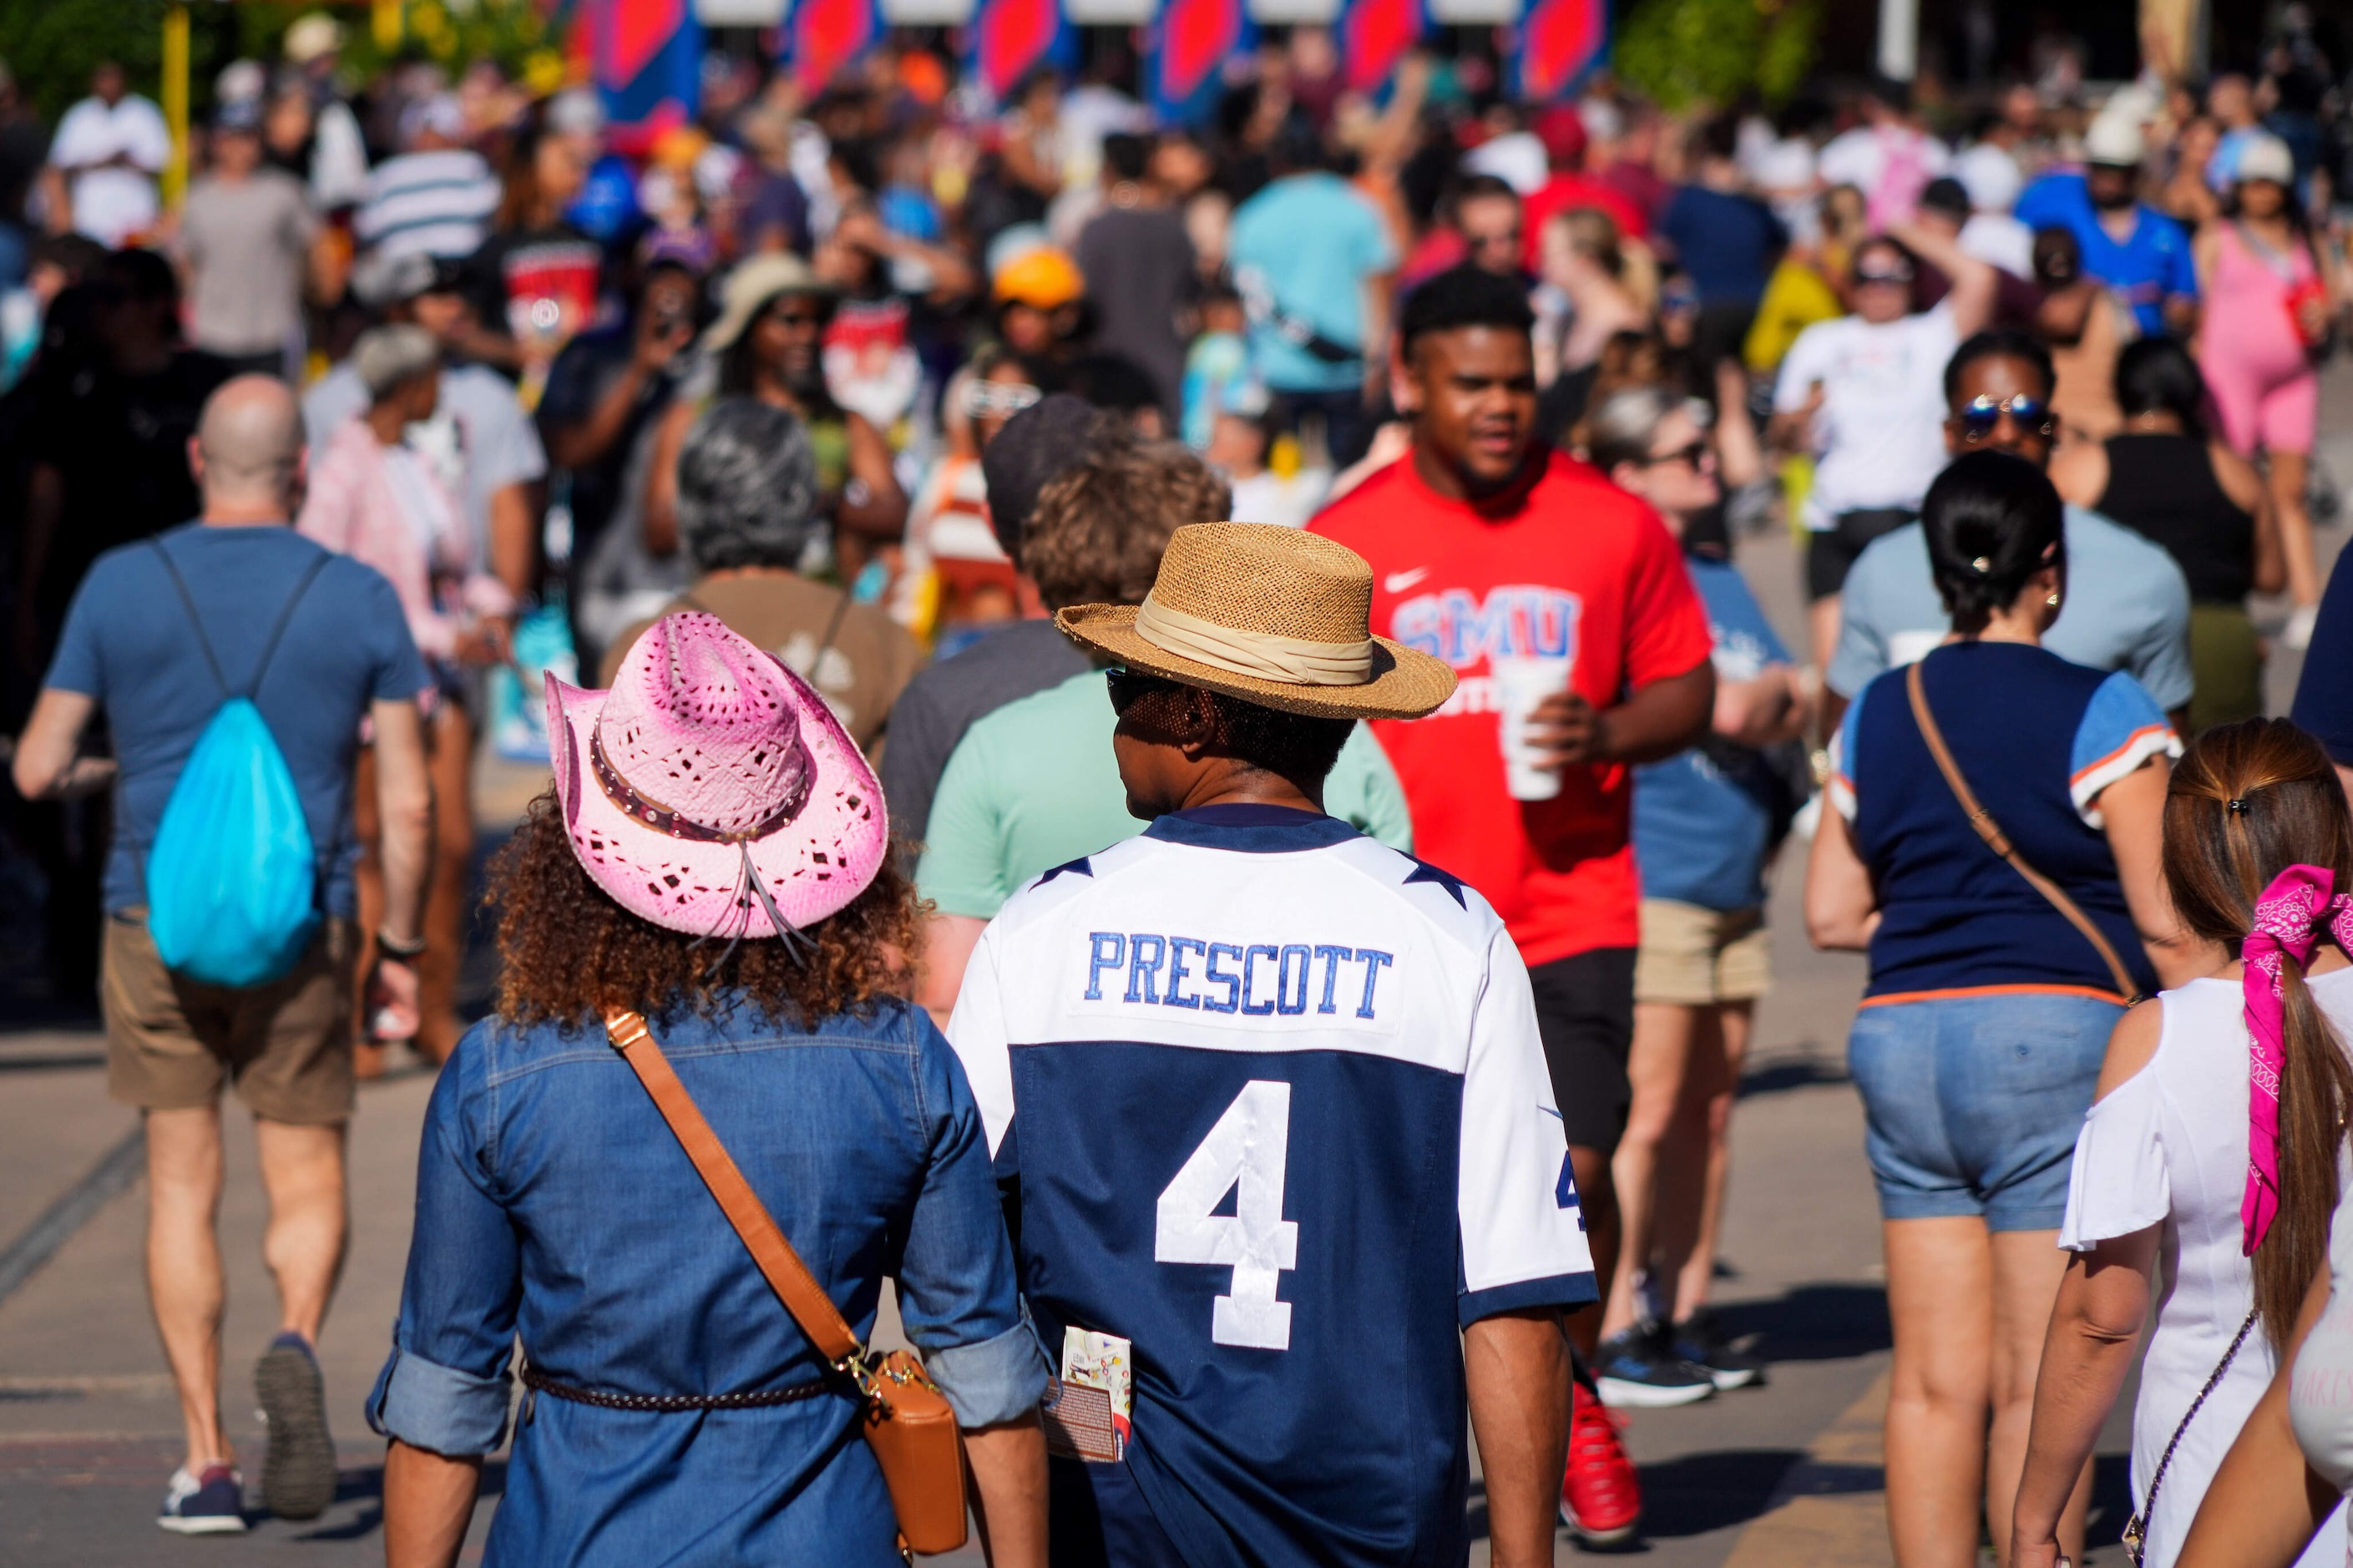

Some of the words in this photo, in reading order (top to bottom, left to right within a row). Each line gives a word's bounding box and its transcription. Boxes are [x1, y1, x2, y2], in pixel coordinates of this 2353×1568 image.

[1389, 584, 1582, 666] SMU
[1084, 931, 1394, 1019] PRESCOTT
[1155, 1080, 1298, 1350] 4
[1555, 1150, 1586, 1232] 4
